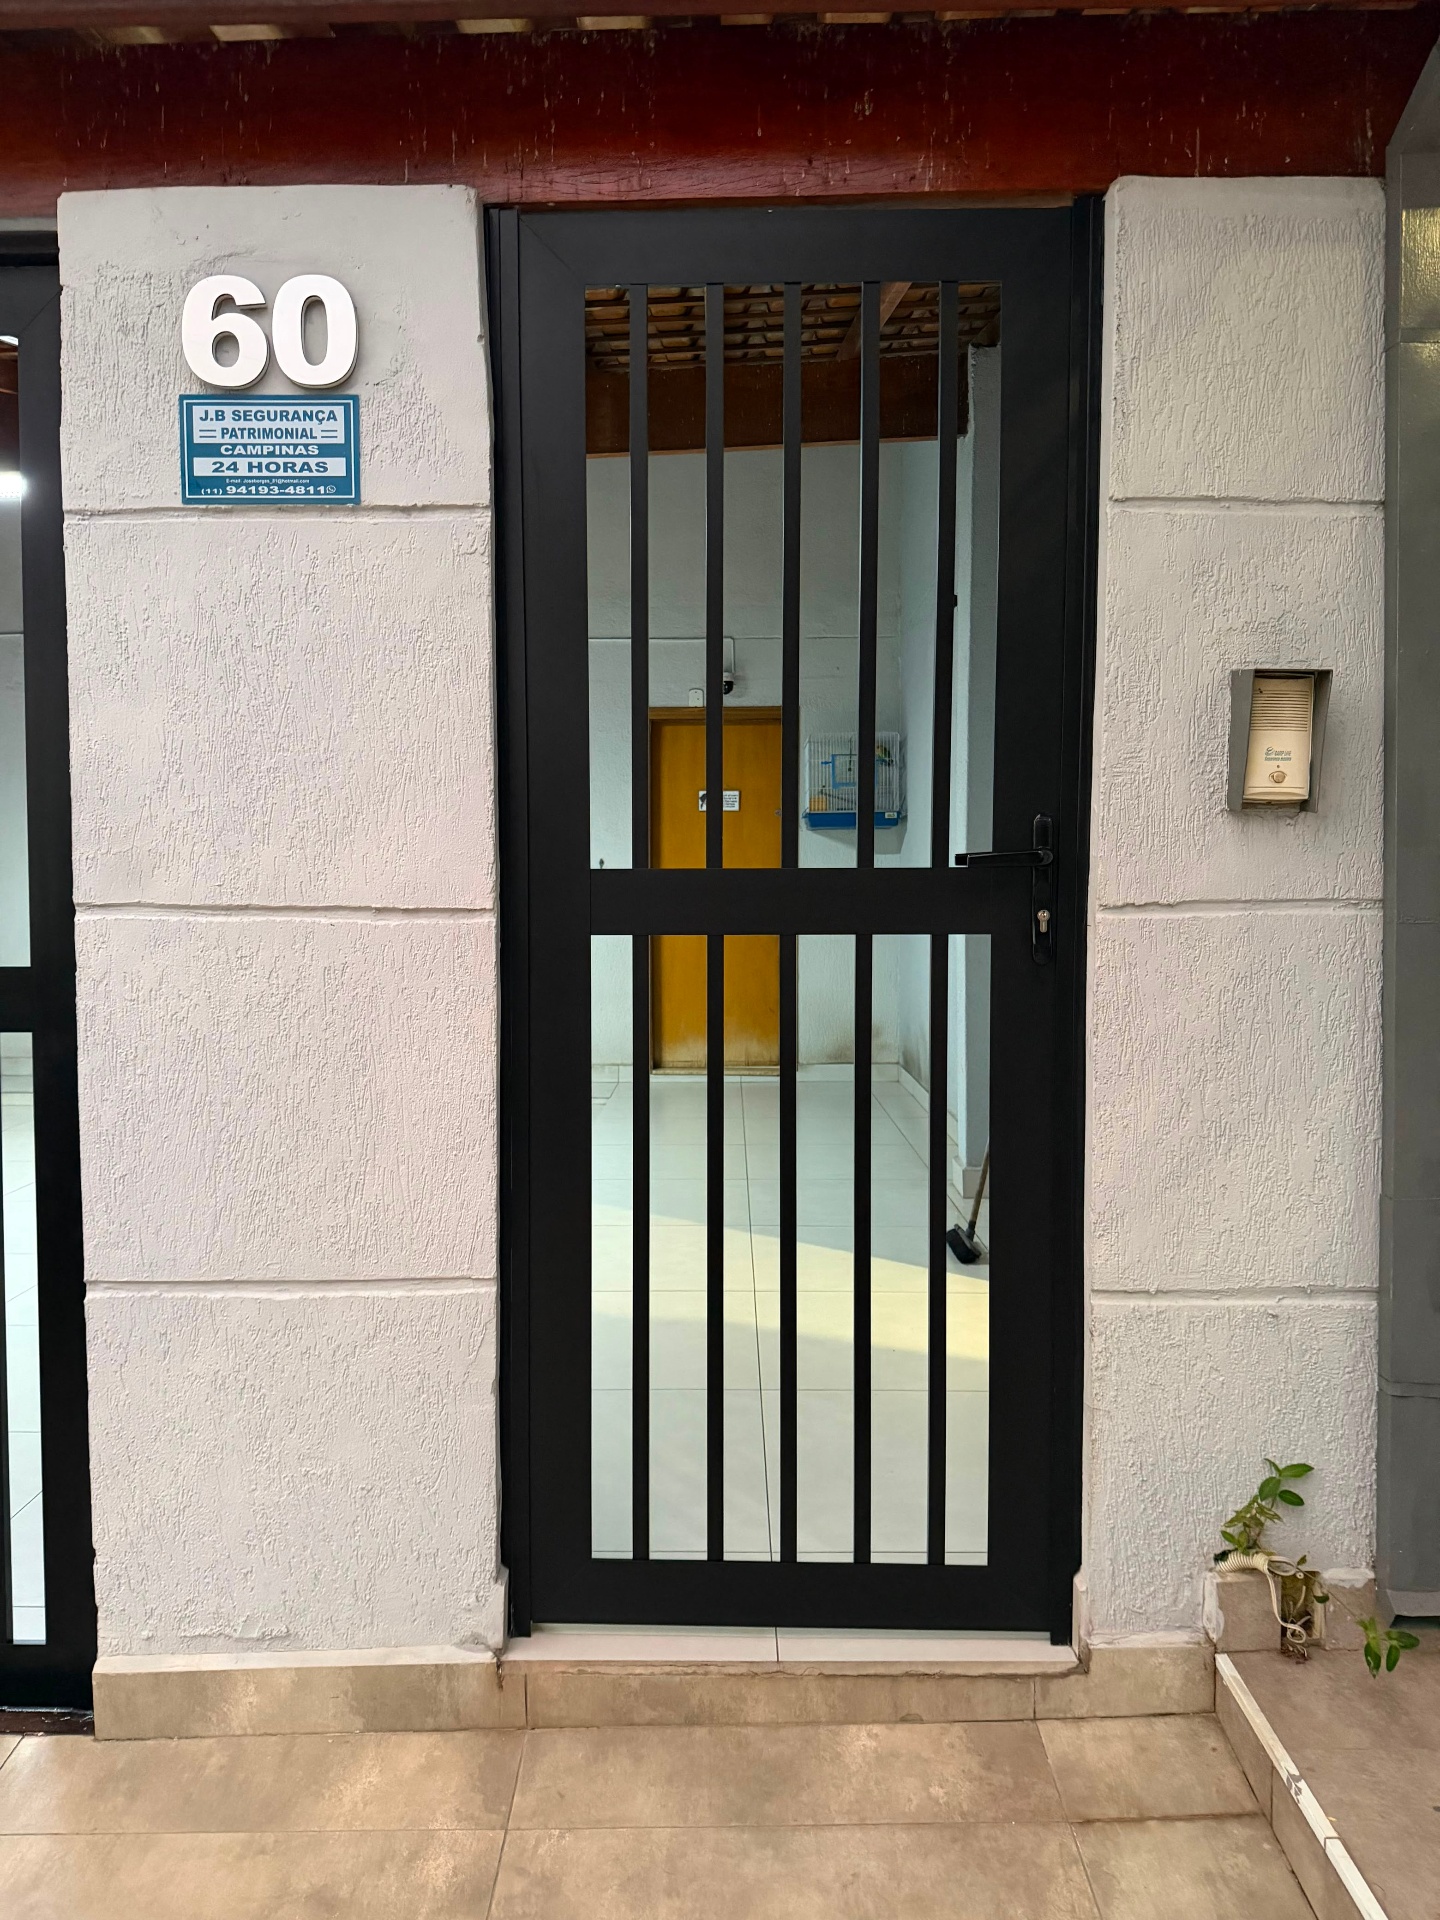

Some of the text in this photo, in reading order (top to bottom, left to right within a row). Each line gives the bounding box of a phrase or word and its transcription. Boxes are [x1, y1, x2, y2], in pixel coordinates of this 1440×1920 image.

[182, 274, 357, 388] 60
[199, 409, 338, 425] J.B SEGURANÇA
[221, 427, 318, 440] PATRIMONIAL
[220, 444, 319, 455] CAMPINAS
[211, 461, 329, 473] 24 HORAS
[200, 485, 325, 495] (11) 94193-4811
